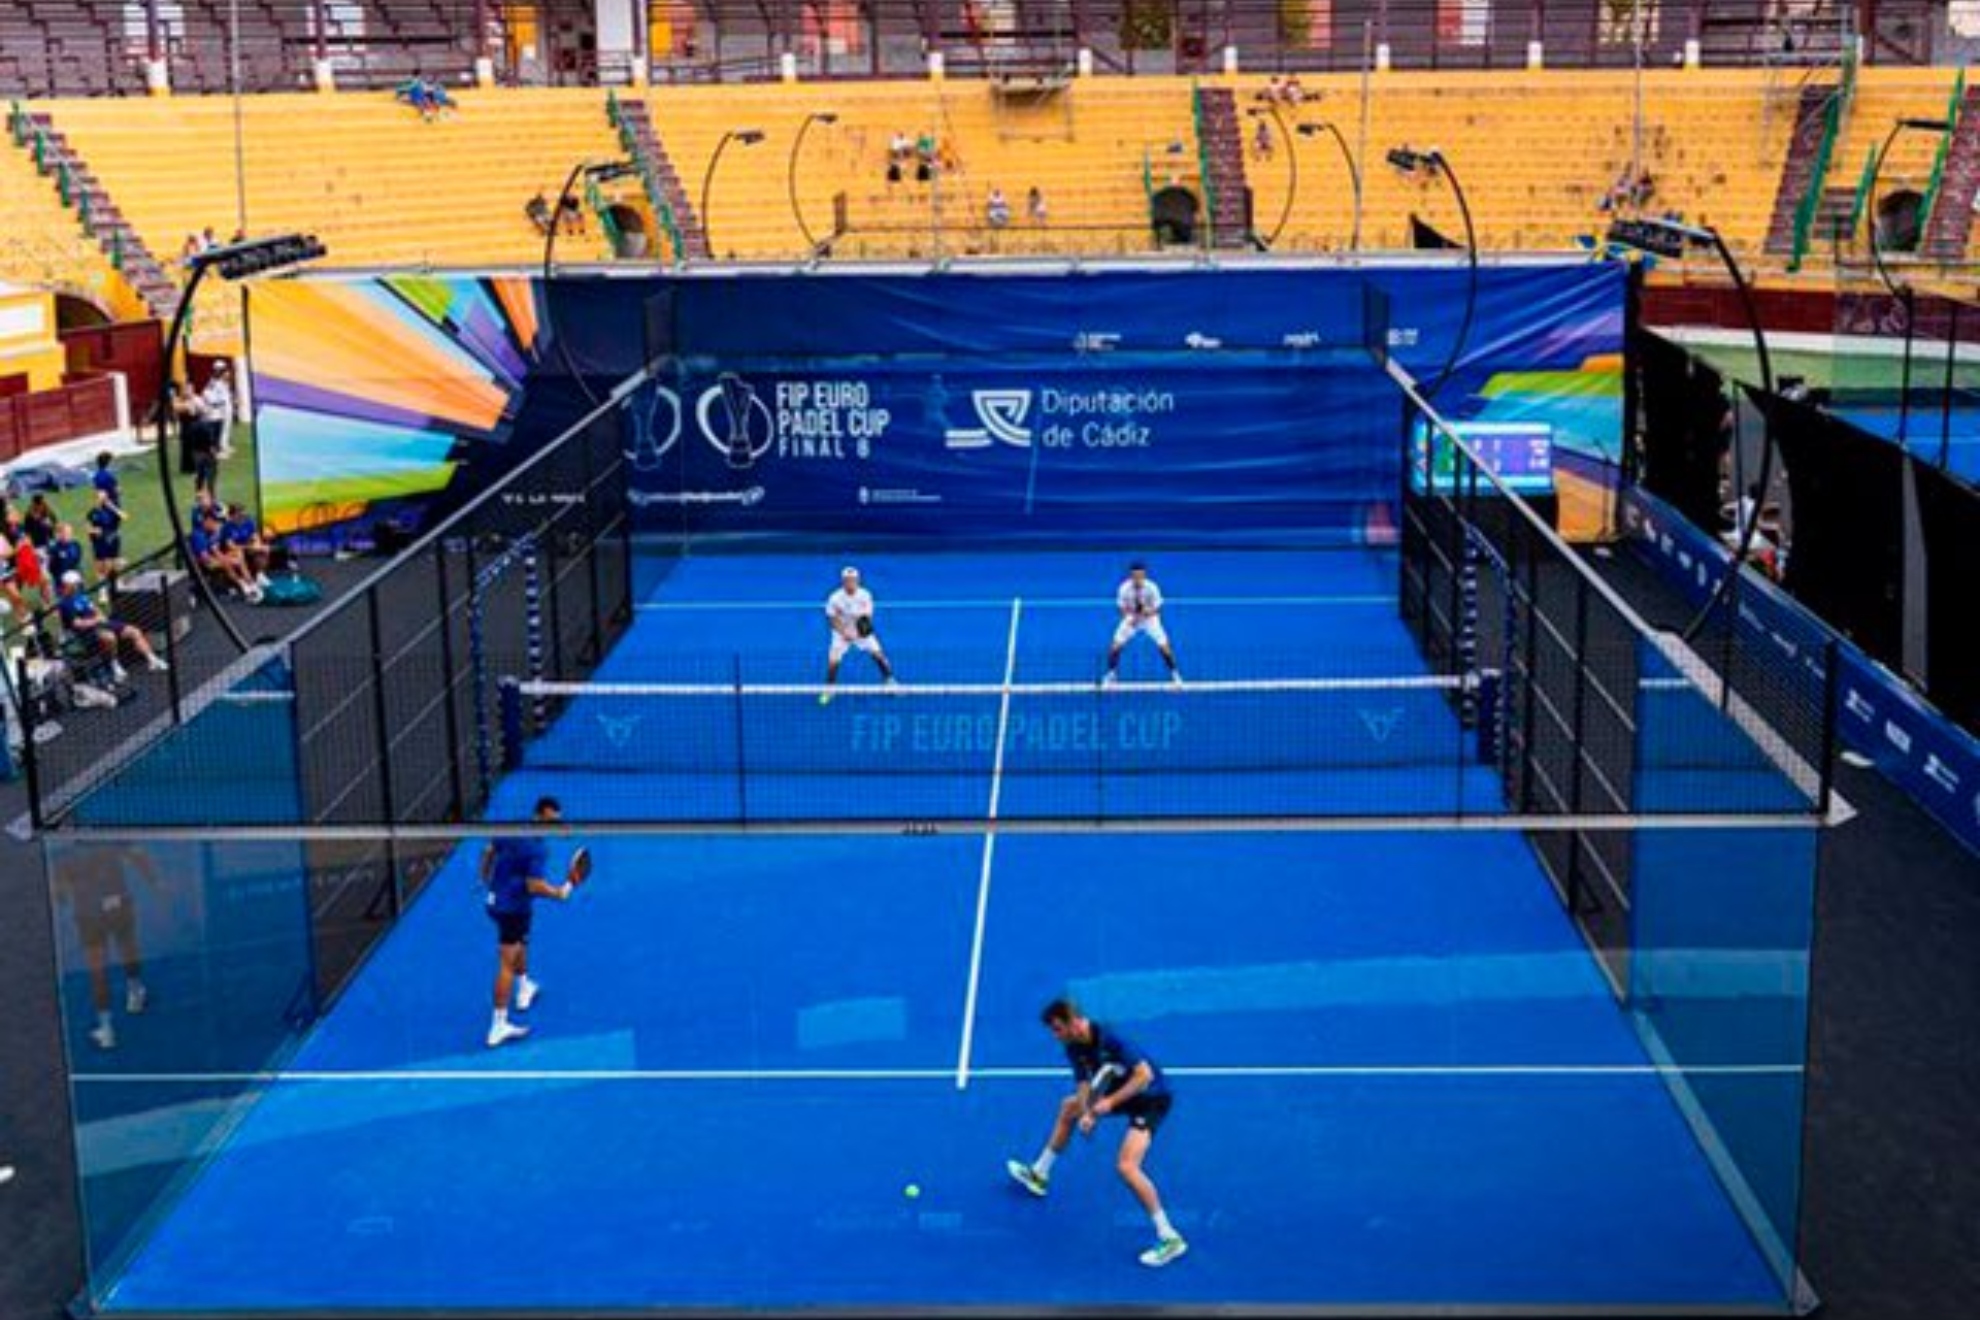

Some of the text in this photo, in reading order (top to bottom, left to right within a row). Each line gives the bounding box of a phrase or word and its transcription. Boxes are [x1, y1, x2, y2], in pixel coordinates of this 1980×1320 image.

[776, 382, 869, 408] FIP EURO
[1042, 387, 1174, 416] Diputación
[777, 409, 890, 436] PADEL CUP
[1042, 421, 1151, 447] de Cádiz
[779, 438, 845, 458] FINAL
[851, 710, 1182, 751] FIP EURO PADEL CUP
